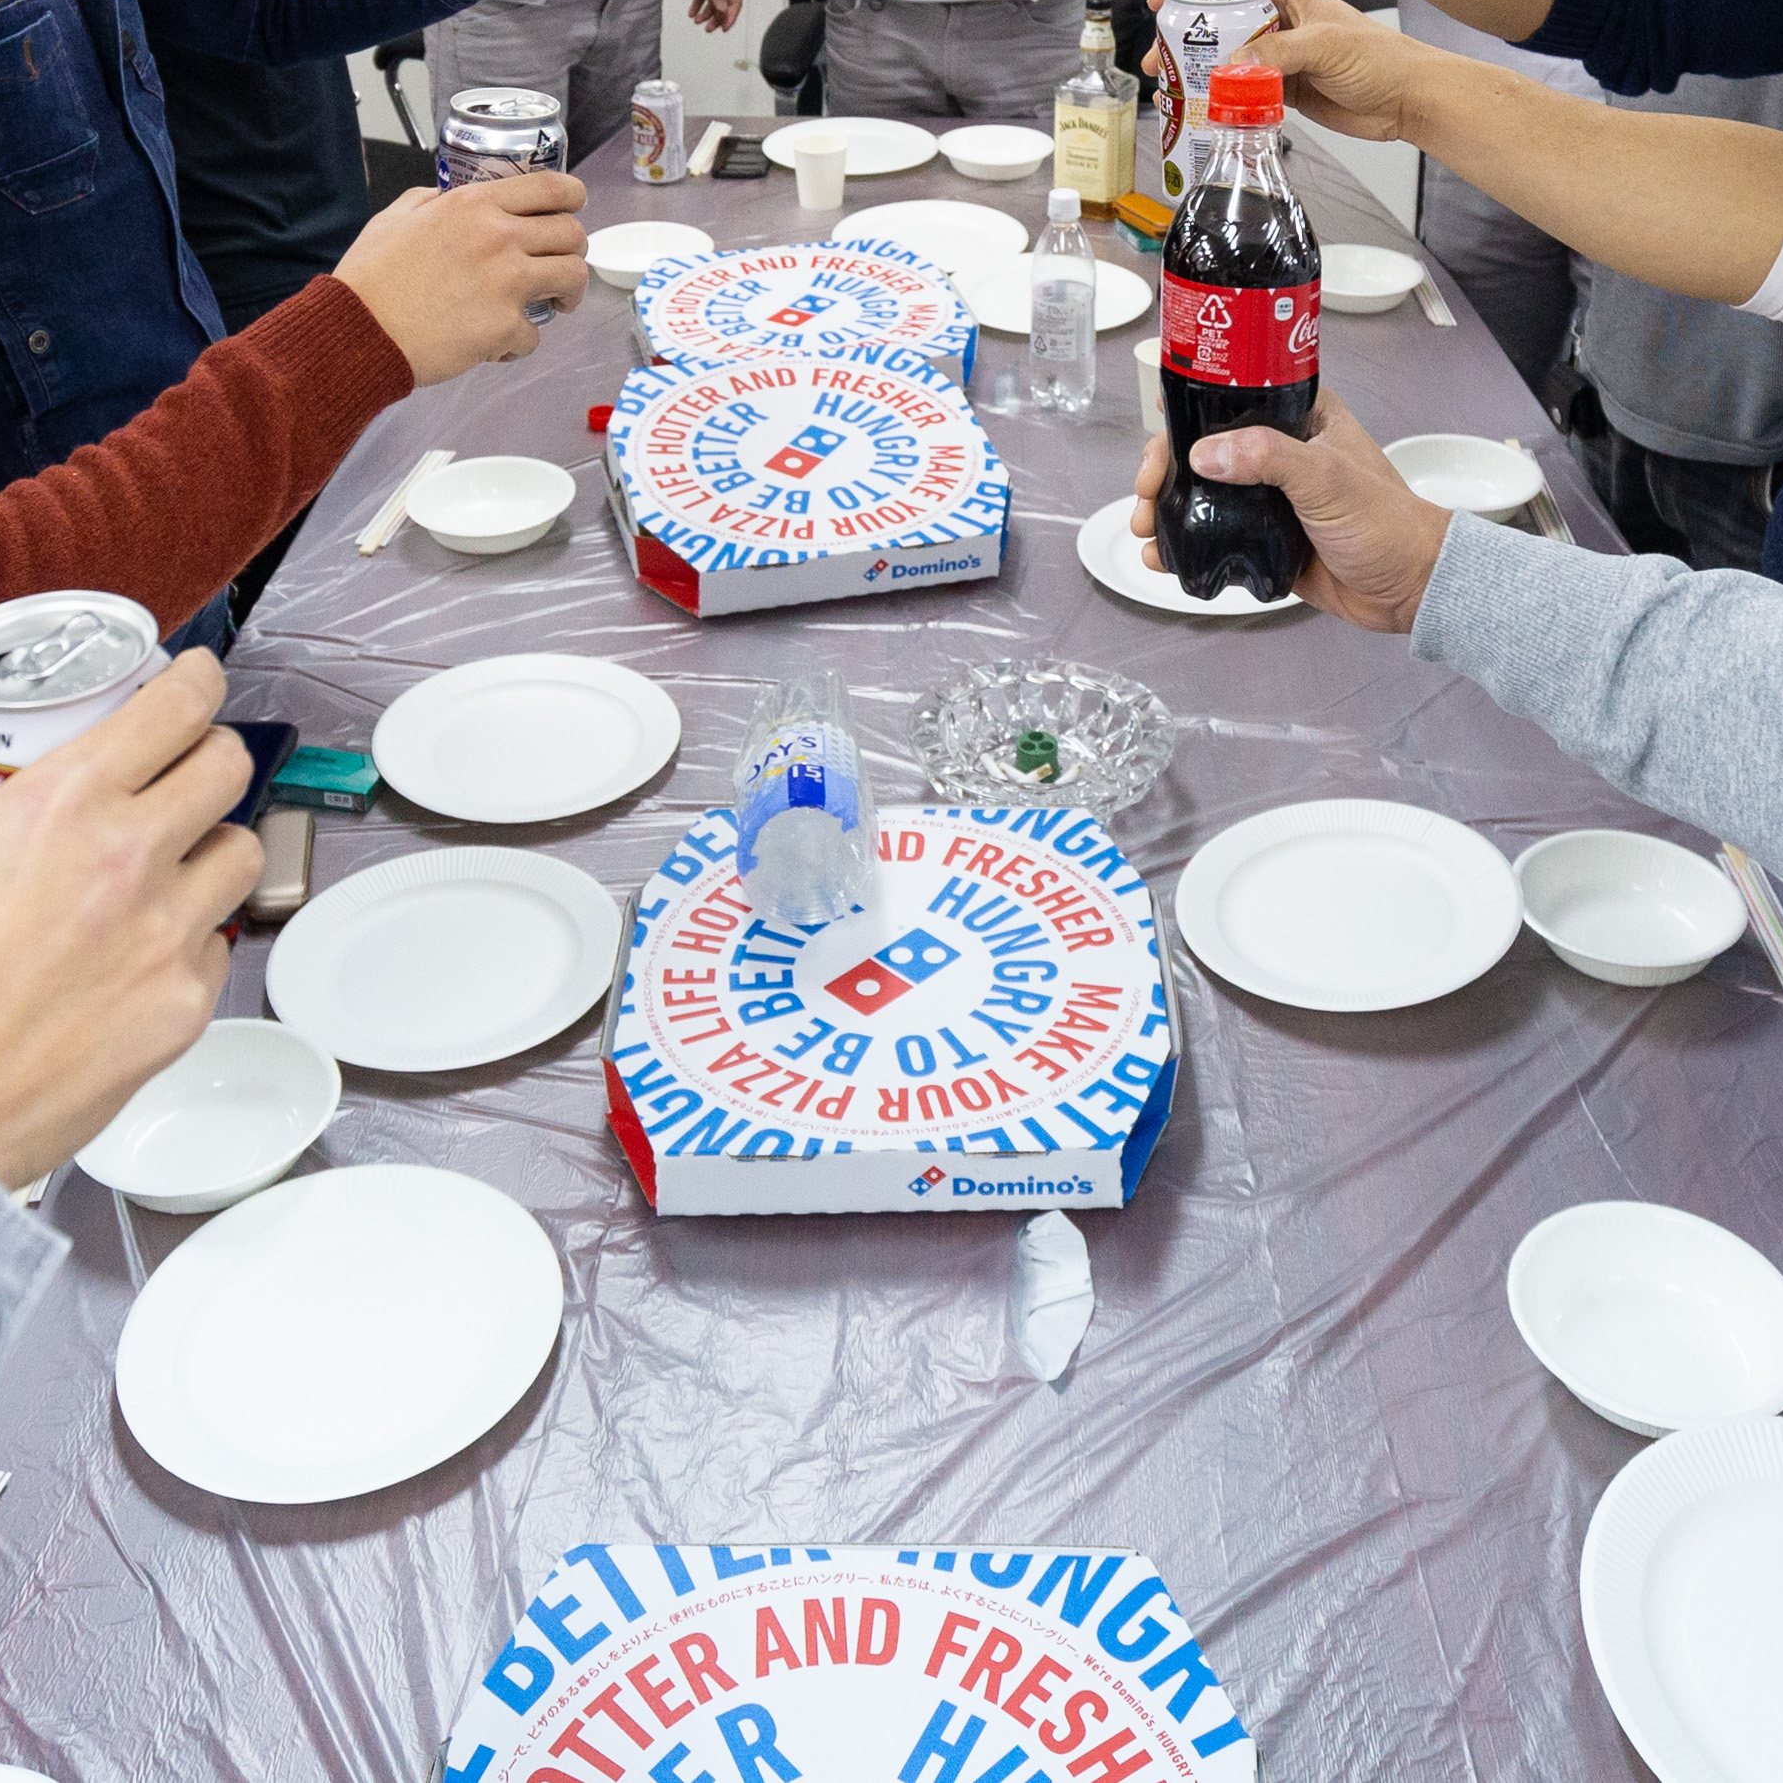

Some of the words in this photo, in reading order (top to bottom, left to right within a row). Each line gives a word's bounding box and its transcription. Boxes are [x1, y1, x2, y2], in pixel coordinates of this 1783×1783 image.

[739, 255, 798, 275] AND
[810, 255, 925, 295] FRESHER
[665, 269, 738, 314] HOTTER
[705, 279, 772, 337] BETTER
[810, 272, 900, 330] HUNGRY
[667, 319, 720, 347] LIFE
[750, 330, 804, 348] BE
[818, 327, 873, 345] TO
[889, 304, 938, 338] MAKE
[1201, 328, 1224, 339] PET
[728, 368, 797, 396] AND
[811, 367, 946, 429] FRESHER
[646, 385, 729, 455] HOTTER
[813, 391, 920, 486] HUNGRY
[692, 401, 771, 494] BETTER
[648, 463, 713, 510] LIFE
[827, 480, 893, 511] TO
[909, 445, 966, 503] MAKE
[708, 503, 814, 540] PIZZA
[747, 483, 811, 515] BE
[828, 499, 928, 537] YOUR
[891, 555, 981, 579] Domino's
[877, 830, 926, 862] ND
[942, 835, 1115, 953] FRESHER
[926, 875, 1059, 1047] HUNGRY
[662, 968, 733, 1045] LIFE
[772, 1017, 874, 1077] BE
[895, 1026, 989, 1078] TO
[1013, 981, 1123, 1082] MAKE
[706, 1040, 857, 1121] PIZZA
[877, 1068, 1030, 1123] YOUR
[952, 1174, 1094, 1196] Domino's
[756, 1596, 901, 1679] AND
[924, 1611, 1161, 1783] FRESH
[1084, 1654, 1113, 1683] We're
[1112, 1680, 1156, 1731] Domino's,
[1156, 1730, 1194, 1779] HUNGRY
